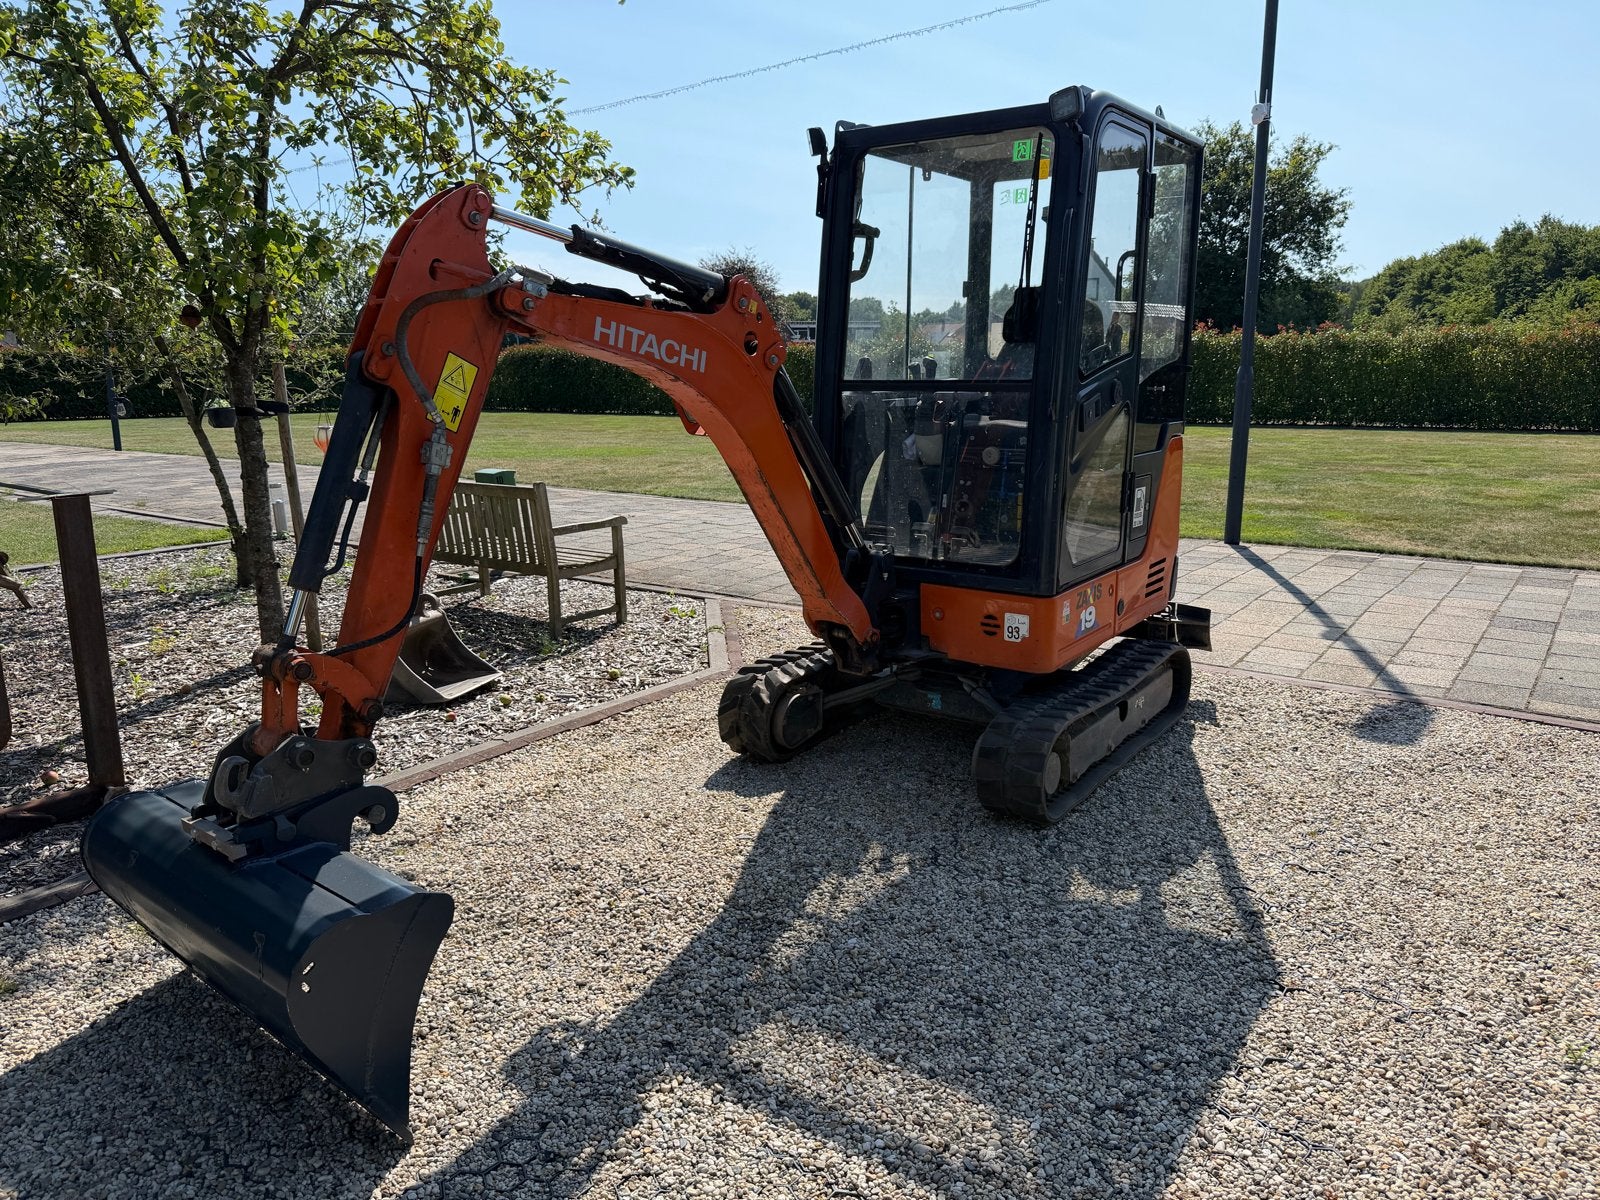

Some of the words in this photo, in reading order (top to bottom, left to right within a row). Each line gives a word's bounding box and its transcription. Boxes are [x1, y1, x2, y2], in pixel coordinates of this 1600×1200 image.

[594, 316, 707, 373] HITACHI
[1076, 582, 1102, 610] ZAXIS
[1080, 605, 1096, 631] 19
[1007, 625, 1020, 640] 93
